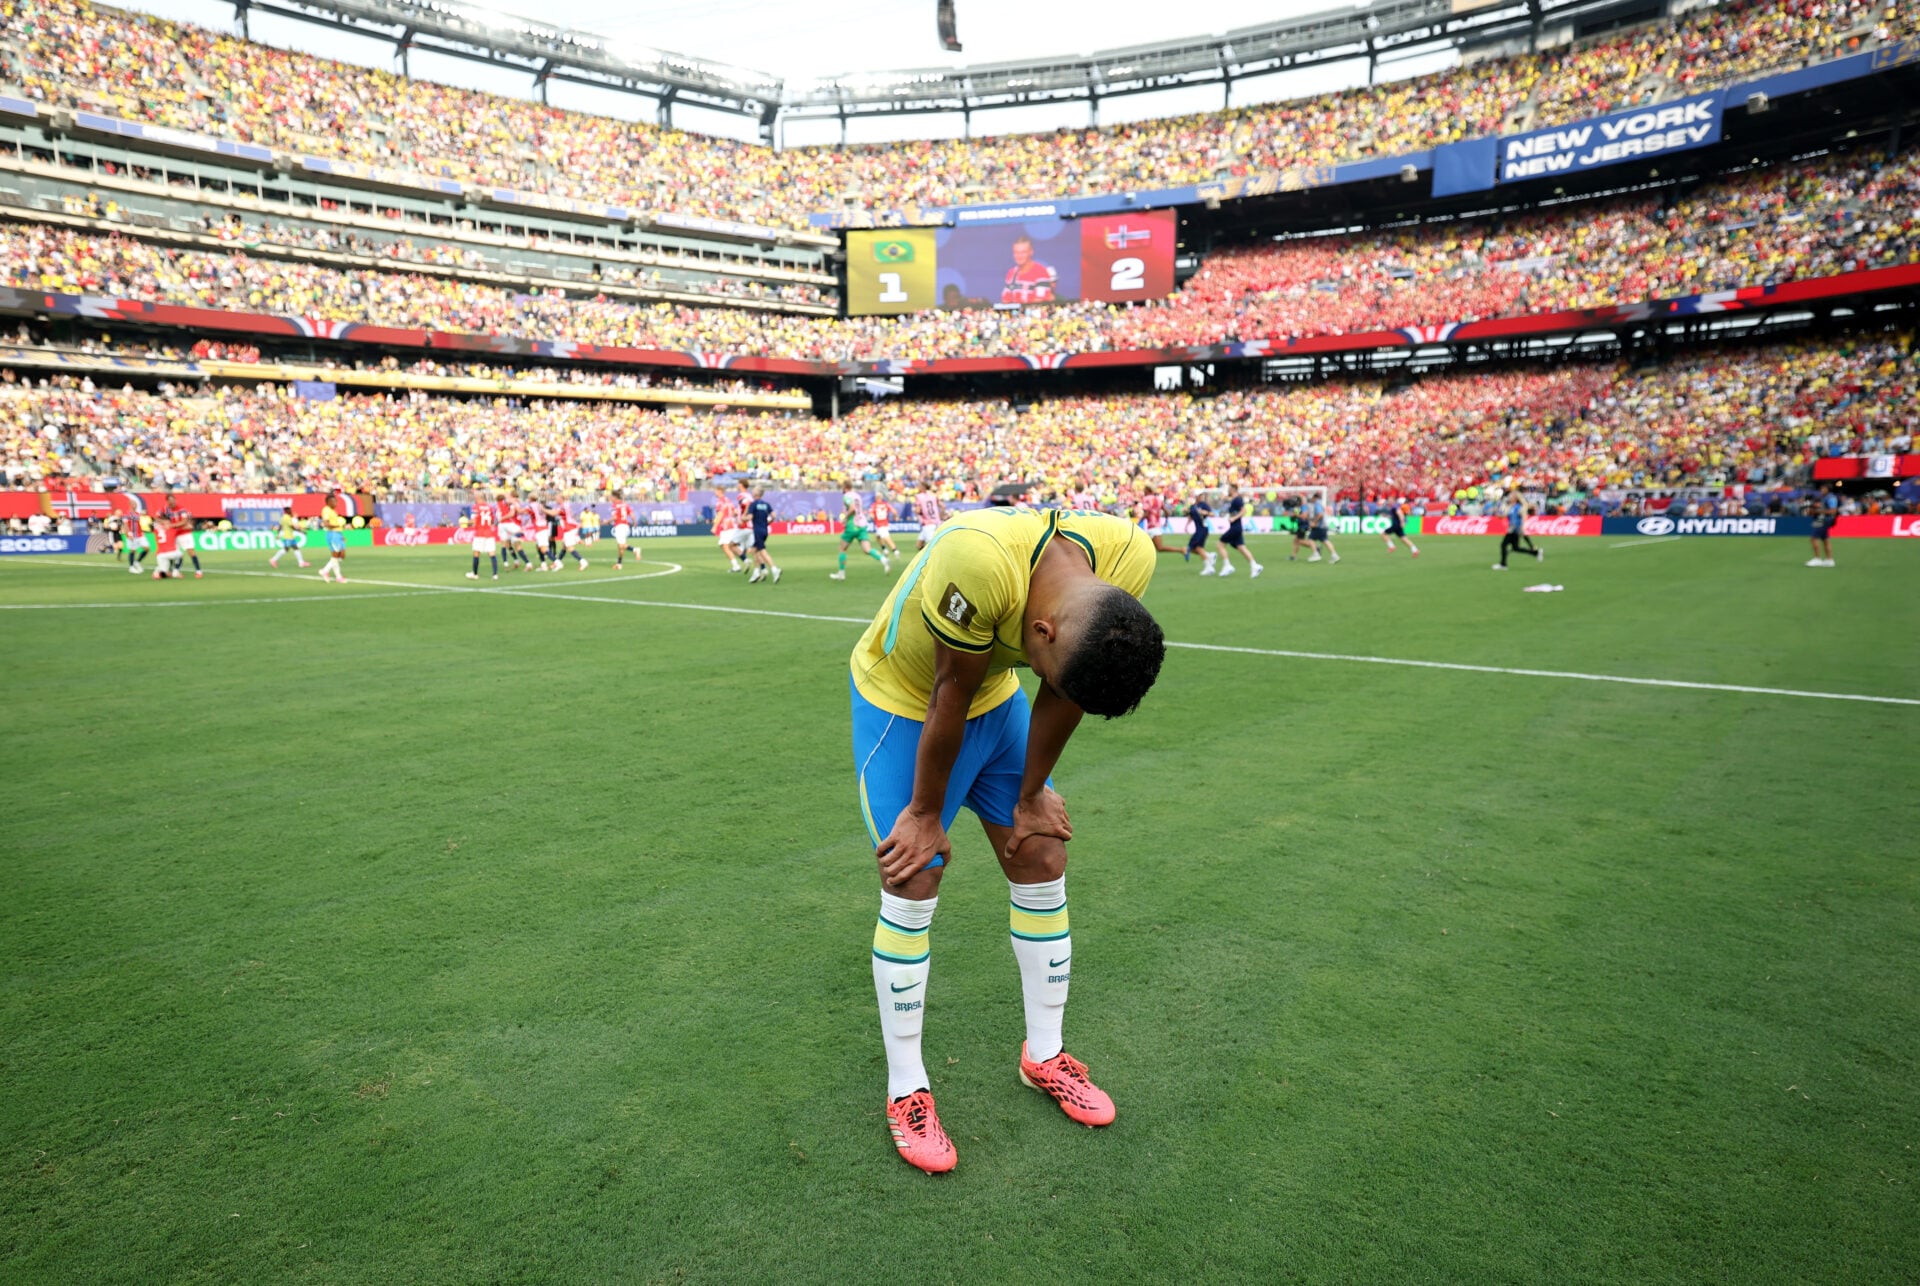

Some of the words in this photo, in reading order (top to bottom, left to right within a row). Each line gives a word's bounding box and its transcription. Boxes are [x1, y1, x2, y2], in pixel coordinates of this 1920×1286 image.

[1506, 125, 1593, 161] NEW
[1599, 98, 1713, 141] YORK
[1505, 151, 1576, 180] NEW
[1579, 123, 1712, 166] JERSEY
[1110, 257, 1145, 291] 2
[878, 272, 909, 303] 1
[787, 522, 826, 534] Lenovo
[1435, 515, 1492, 535] Coca-Cola
[1677, 518, 1776, 534] HYUNDAI
[0, 538, 63, 552] 2026
